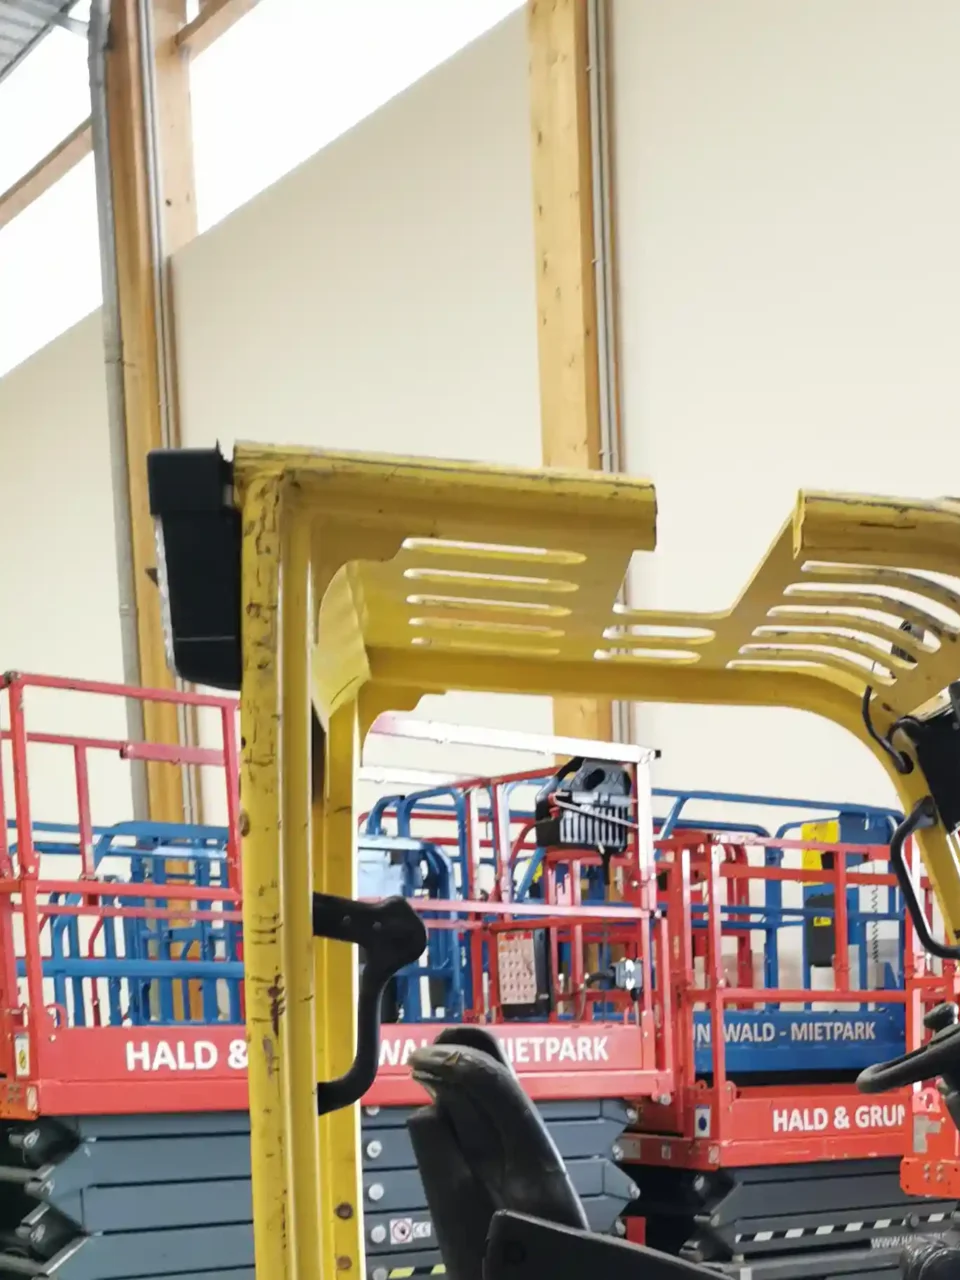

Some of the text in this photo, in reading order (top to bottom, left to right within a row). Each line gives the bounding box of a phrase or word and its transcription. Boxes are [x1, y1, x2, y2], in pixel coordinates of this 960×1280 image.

[790, 1021, 876, 1041] MIETPARK
[126, 1040, 218, 1071] HALD
[228, 1039, 248, 1069] &
[773, 1107, 828, 1132] HALD
[834, 1106, 850, 1129] &
